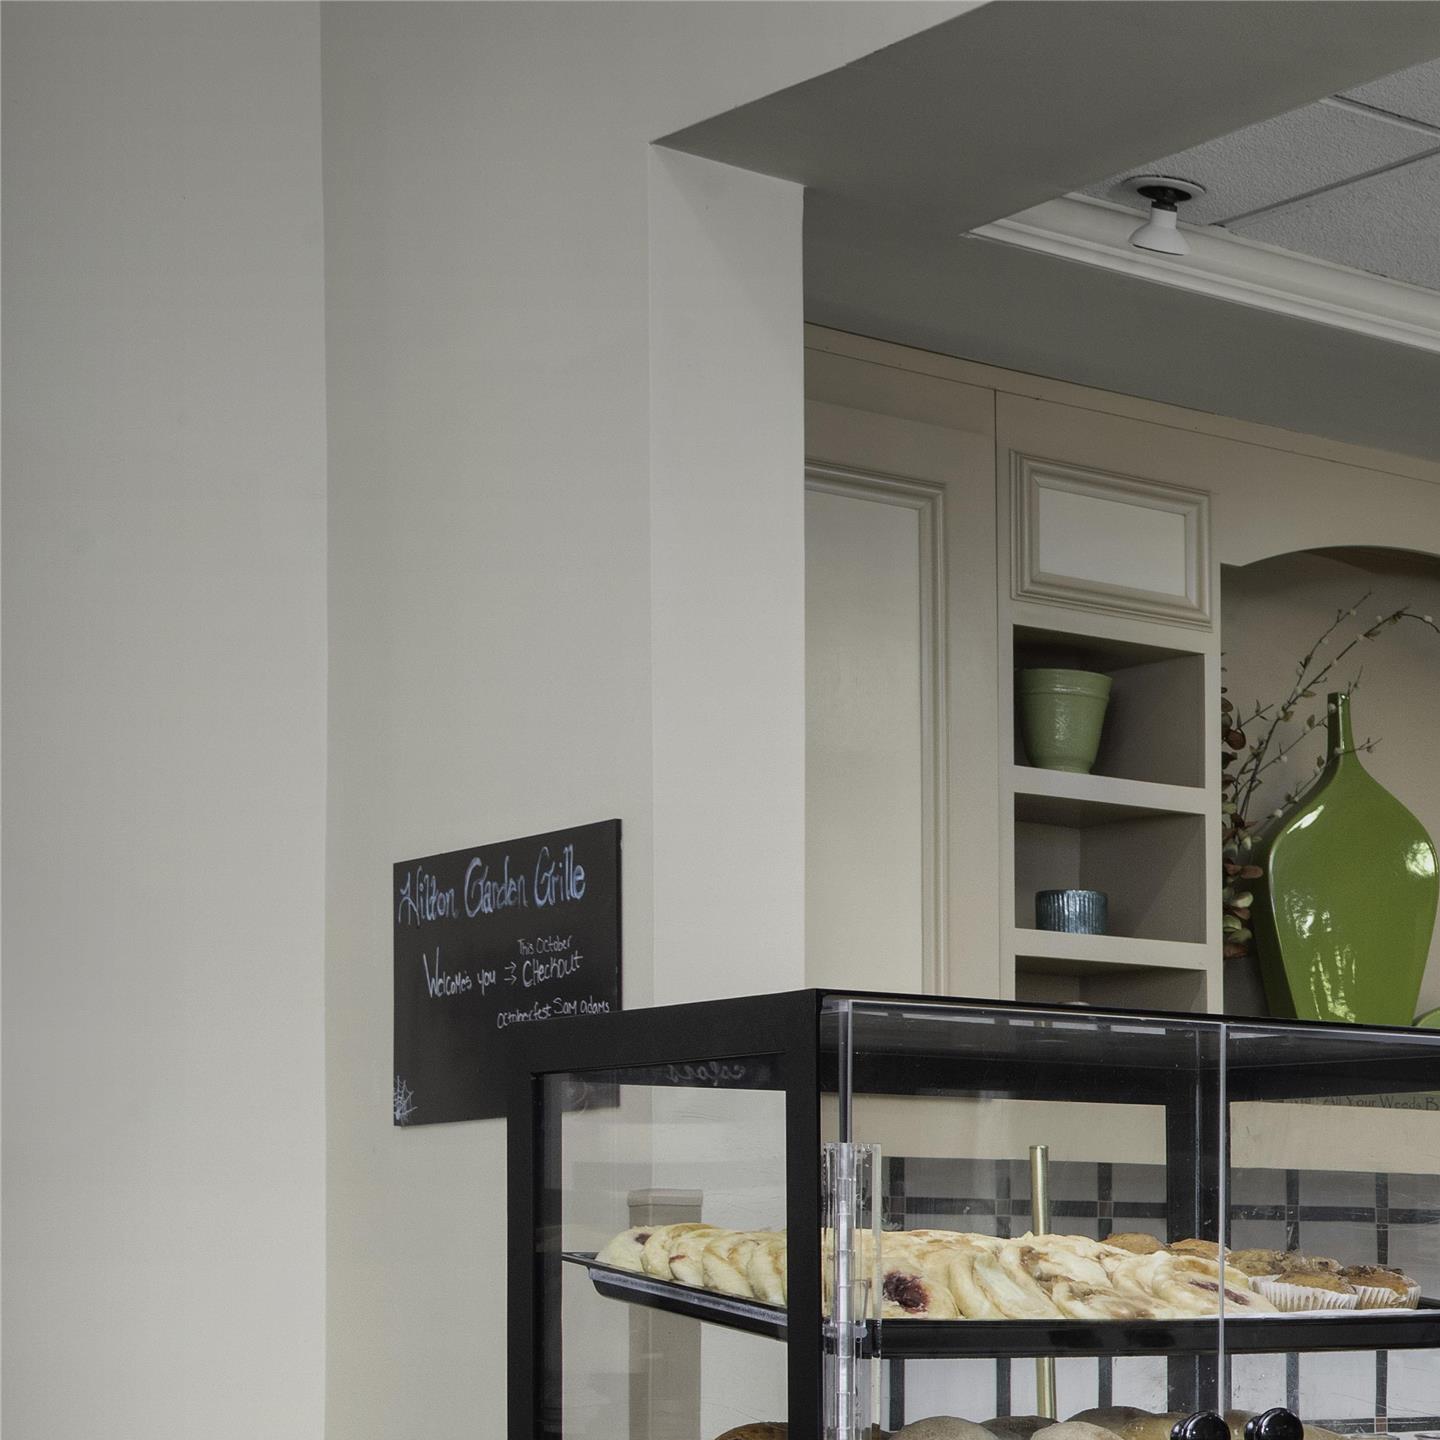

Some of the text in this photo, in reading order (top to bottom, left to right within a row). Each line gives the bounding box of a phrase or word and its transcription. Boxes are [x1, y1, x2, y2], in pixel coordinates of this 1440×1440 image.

[398, 844, 587, 926] Hilton Garden Grille
[517, 935, 573, 956] This October
[477, 968, 497, 996] you
